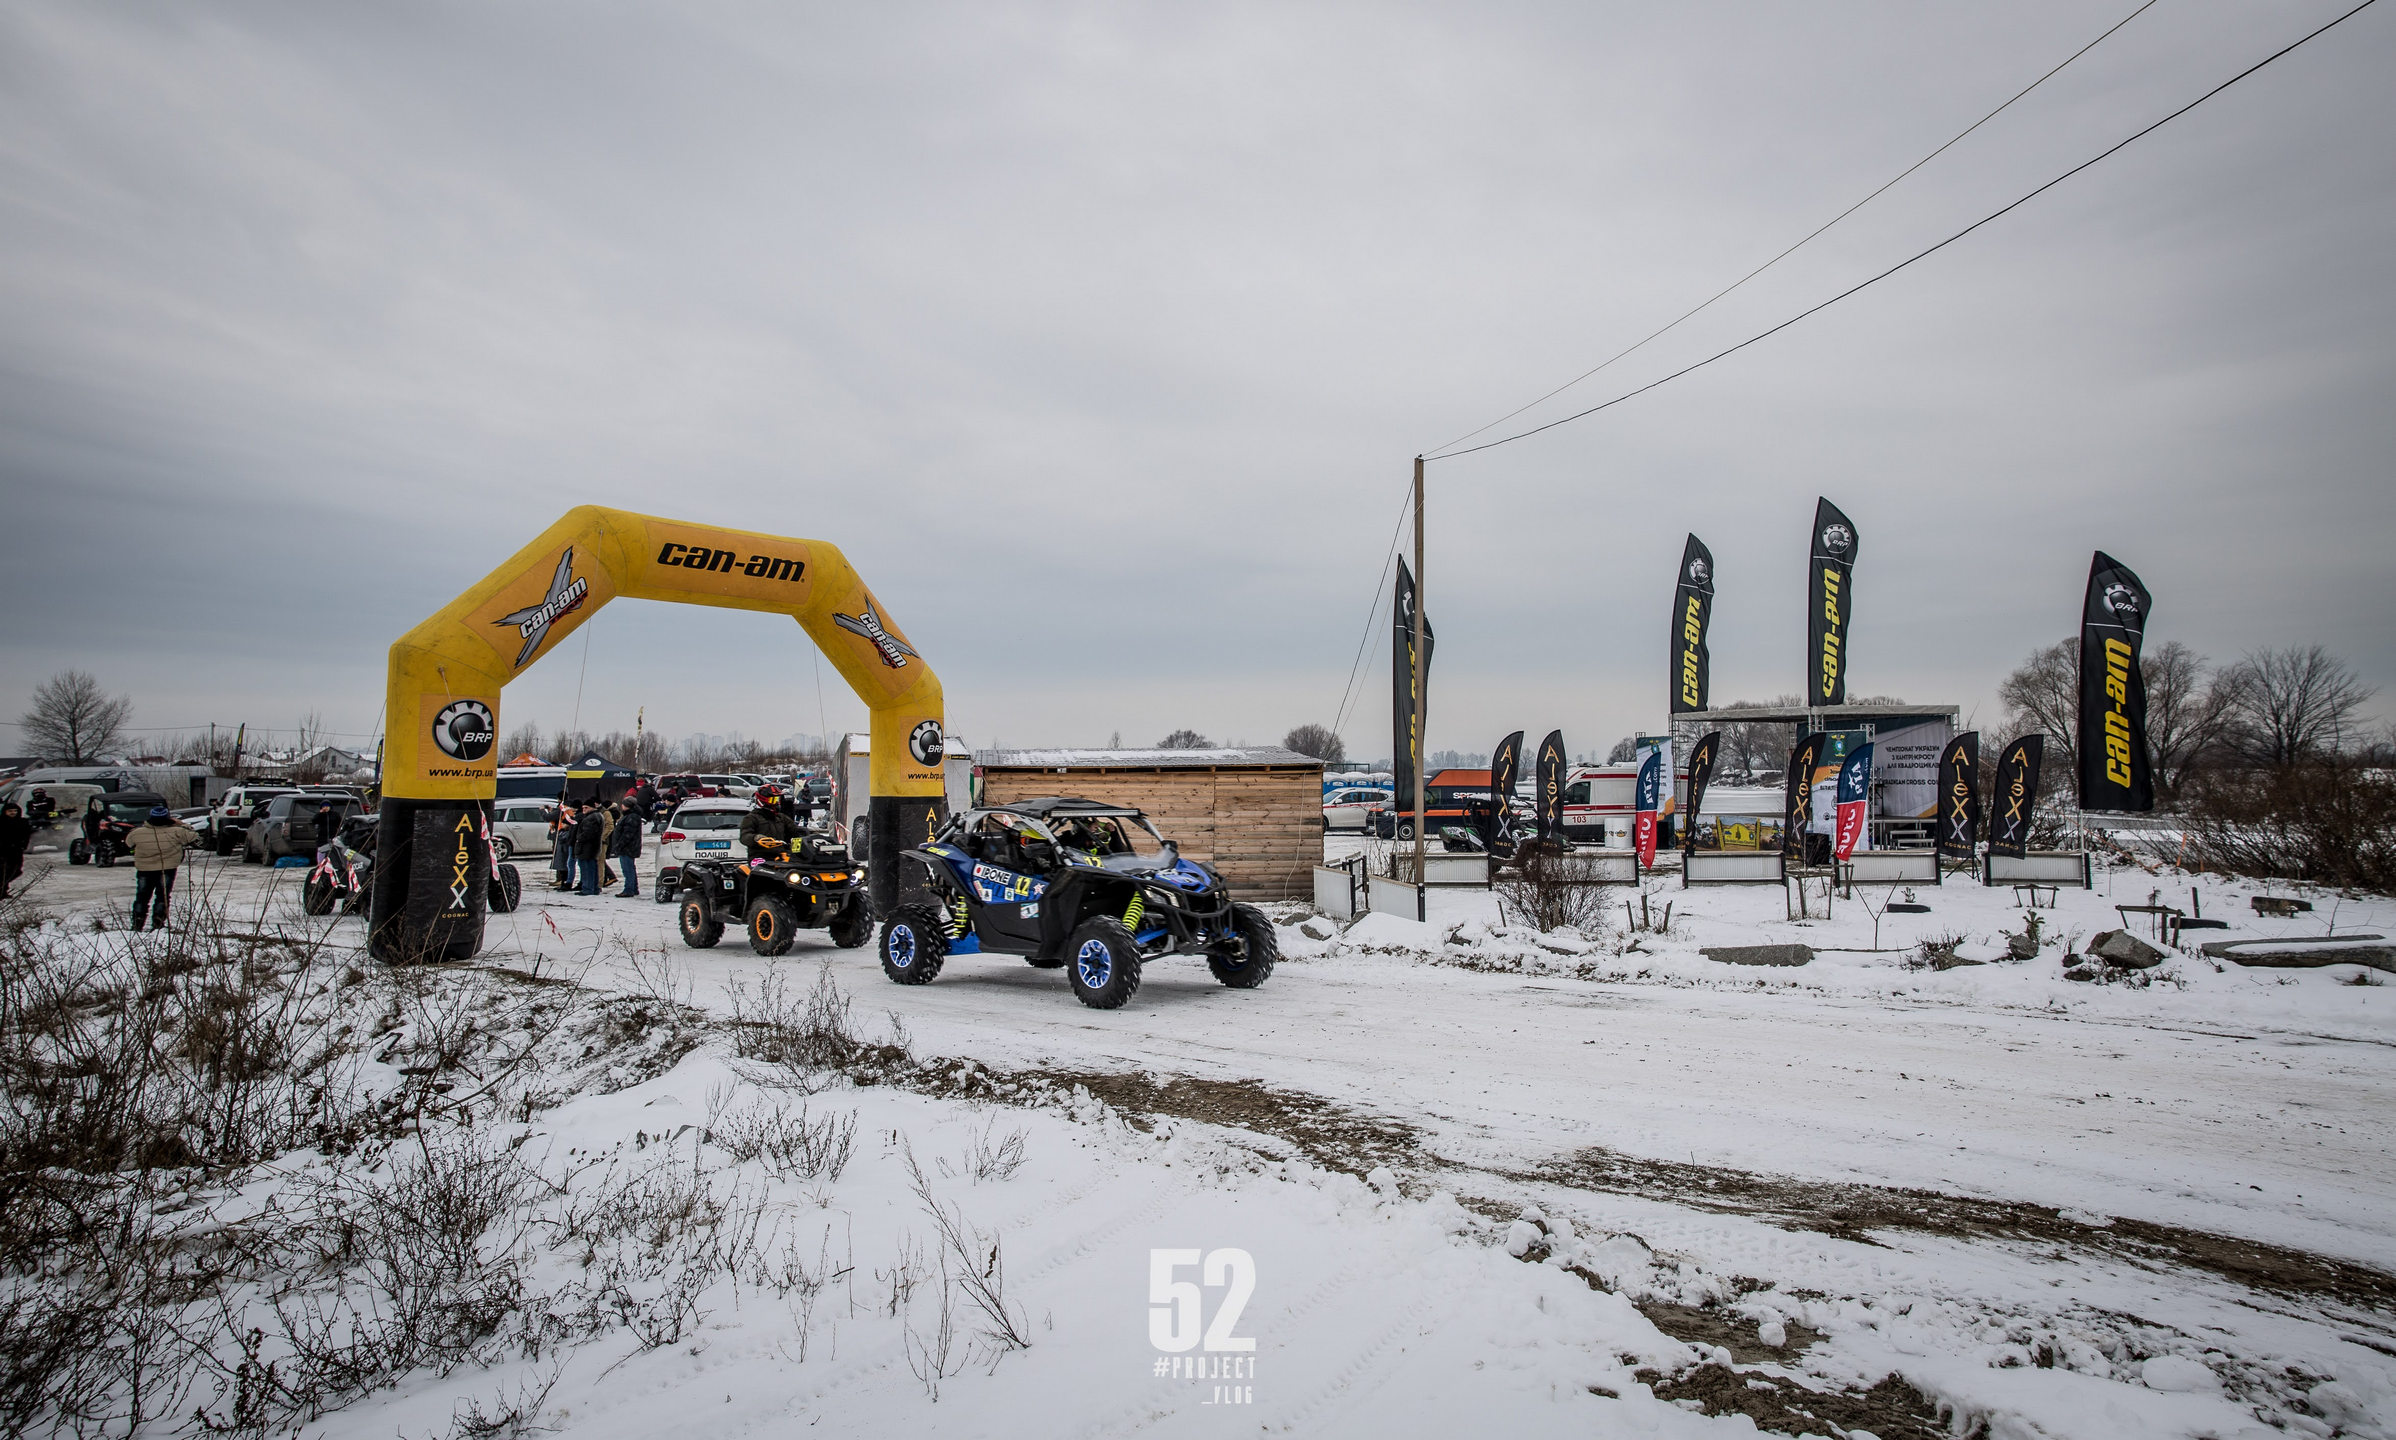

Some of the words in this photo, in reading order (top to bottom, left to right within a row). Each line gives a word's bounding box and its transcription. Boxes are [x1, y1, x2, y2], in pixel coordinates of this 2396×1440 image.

[657, 542, 805, 583] can-am
[519, 577, 588, 639] can-am
[859, 612, 908, 669] can-am
[1682, 595, 1702, 708] can-am
[1822, 568, 1841, 698] can-am
[2105, 637, 2132, 789] can-am
[462, 732, 493, 744] BRP
[428, 767, 494, 779] www.brp.ua
[1572, 816, 1587, 824] 103
[981, 866, 1011, 884] IPONE
[1015, 876, 1033, 897] 12
